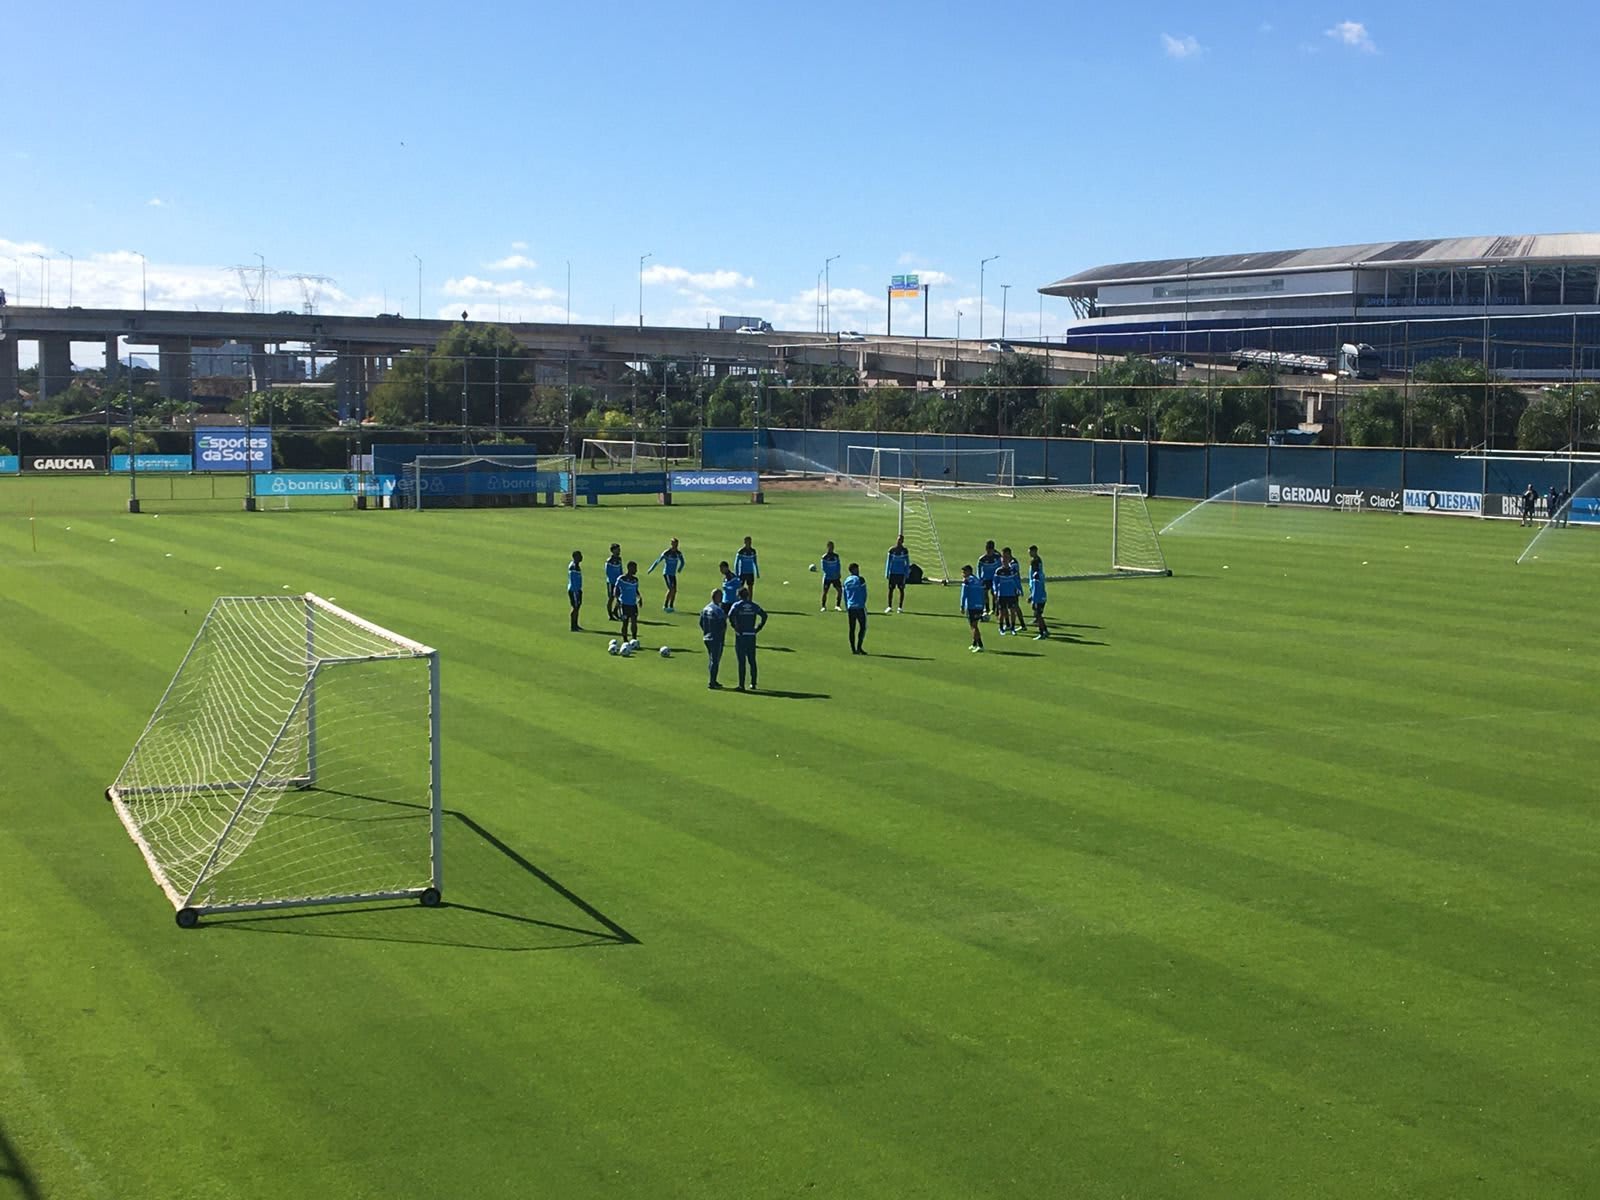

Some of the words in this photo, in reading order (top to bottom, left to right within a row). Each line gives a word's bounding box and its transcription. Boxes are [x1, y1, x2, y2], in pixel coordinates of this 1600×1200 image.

[198, 436, 268, 450] Esportes
[34, 459, 95, 470] GAUCHA
[288, 479, 342, 490] banrisul
[674, 476, 715, 486] Esportes
[1282, 487, 1331, 503] GERDAU
[1370, 494, 1396, 508] Claro
[1405, 491, 1481, 511] MARQUESPAN
